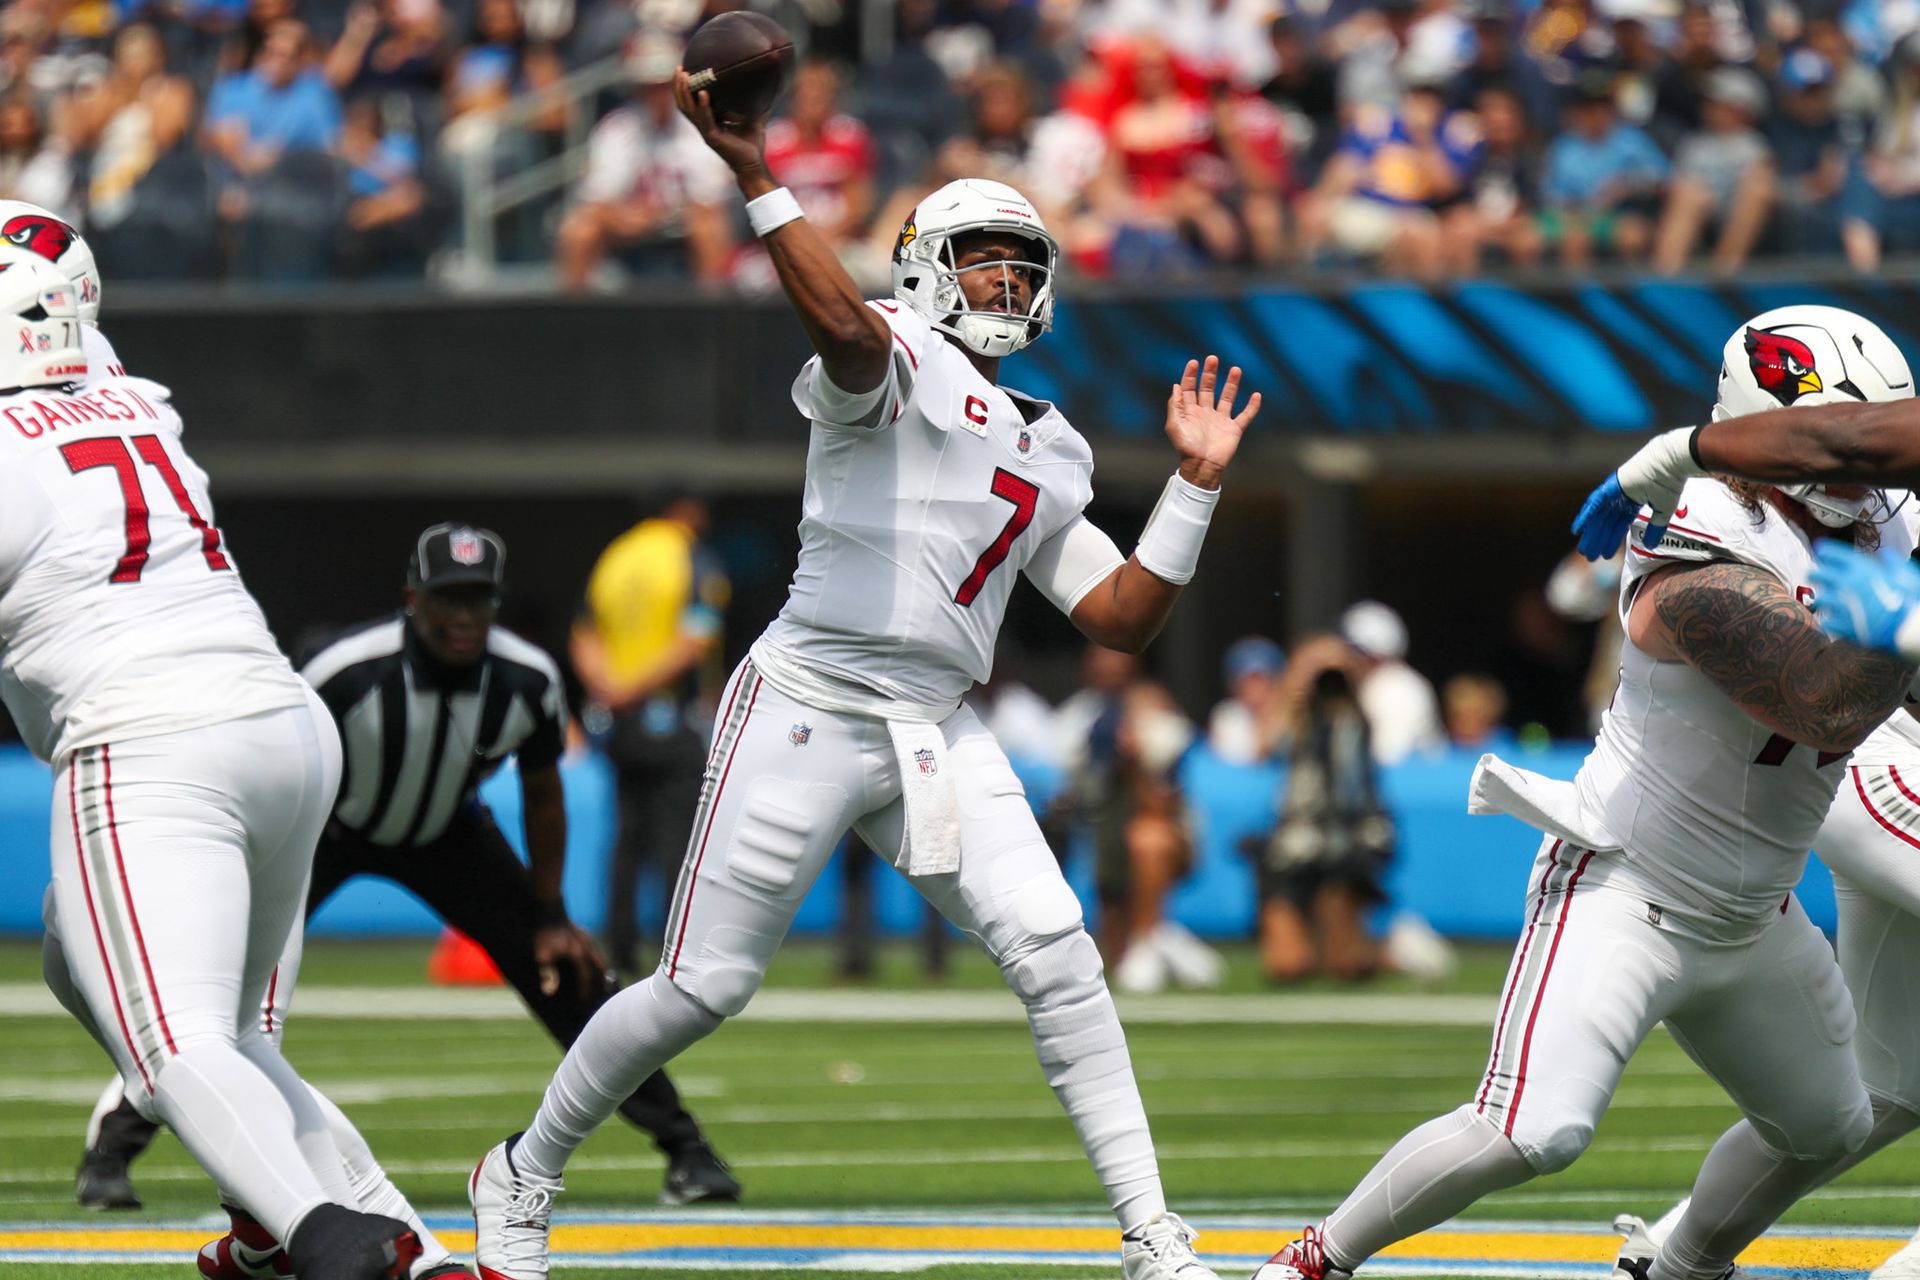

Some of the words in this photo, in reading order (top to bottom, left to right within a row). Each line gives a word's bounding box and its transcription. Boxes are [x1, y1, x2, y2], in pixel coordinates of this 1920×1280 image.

[2, 388, 136, 440] GAINES
[964, 394, 989, 426] C
[58, 433, 232, 583] 71
[954, 466, 1040, 608] 7
[918, 761, 936, 776] NFL
